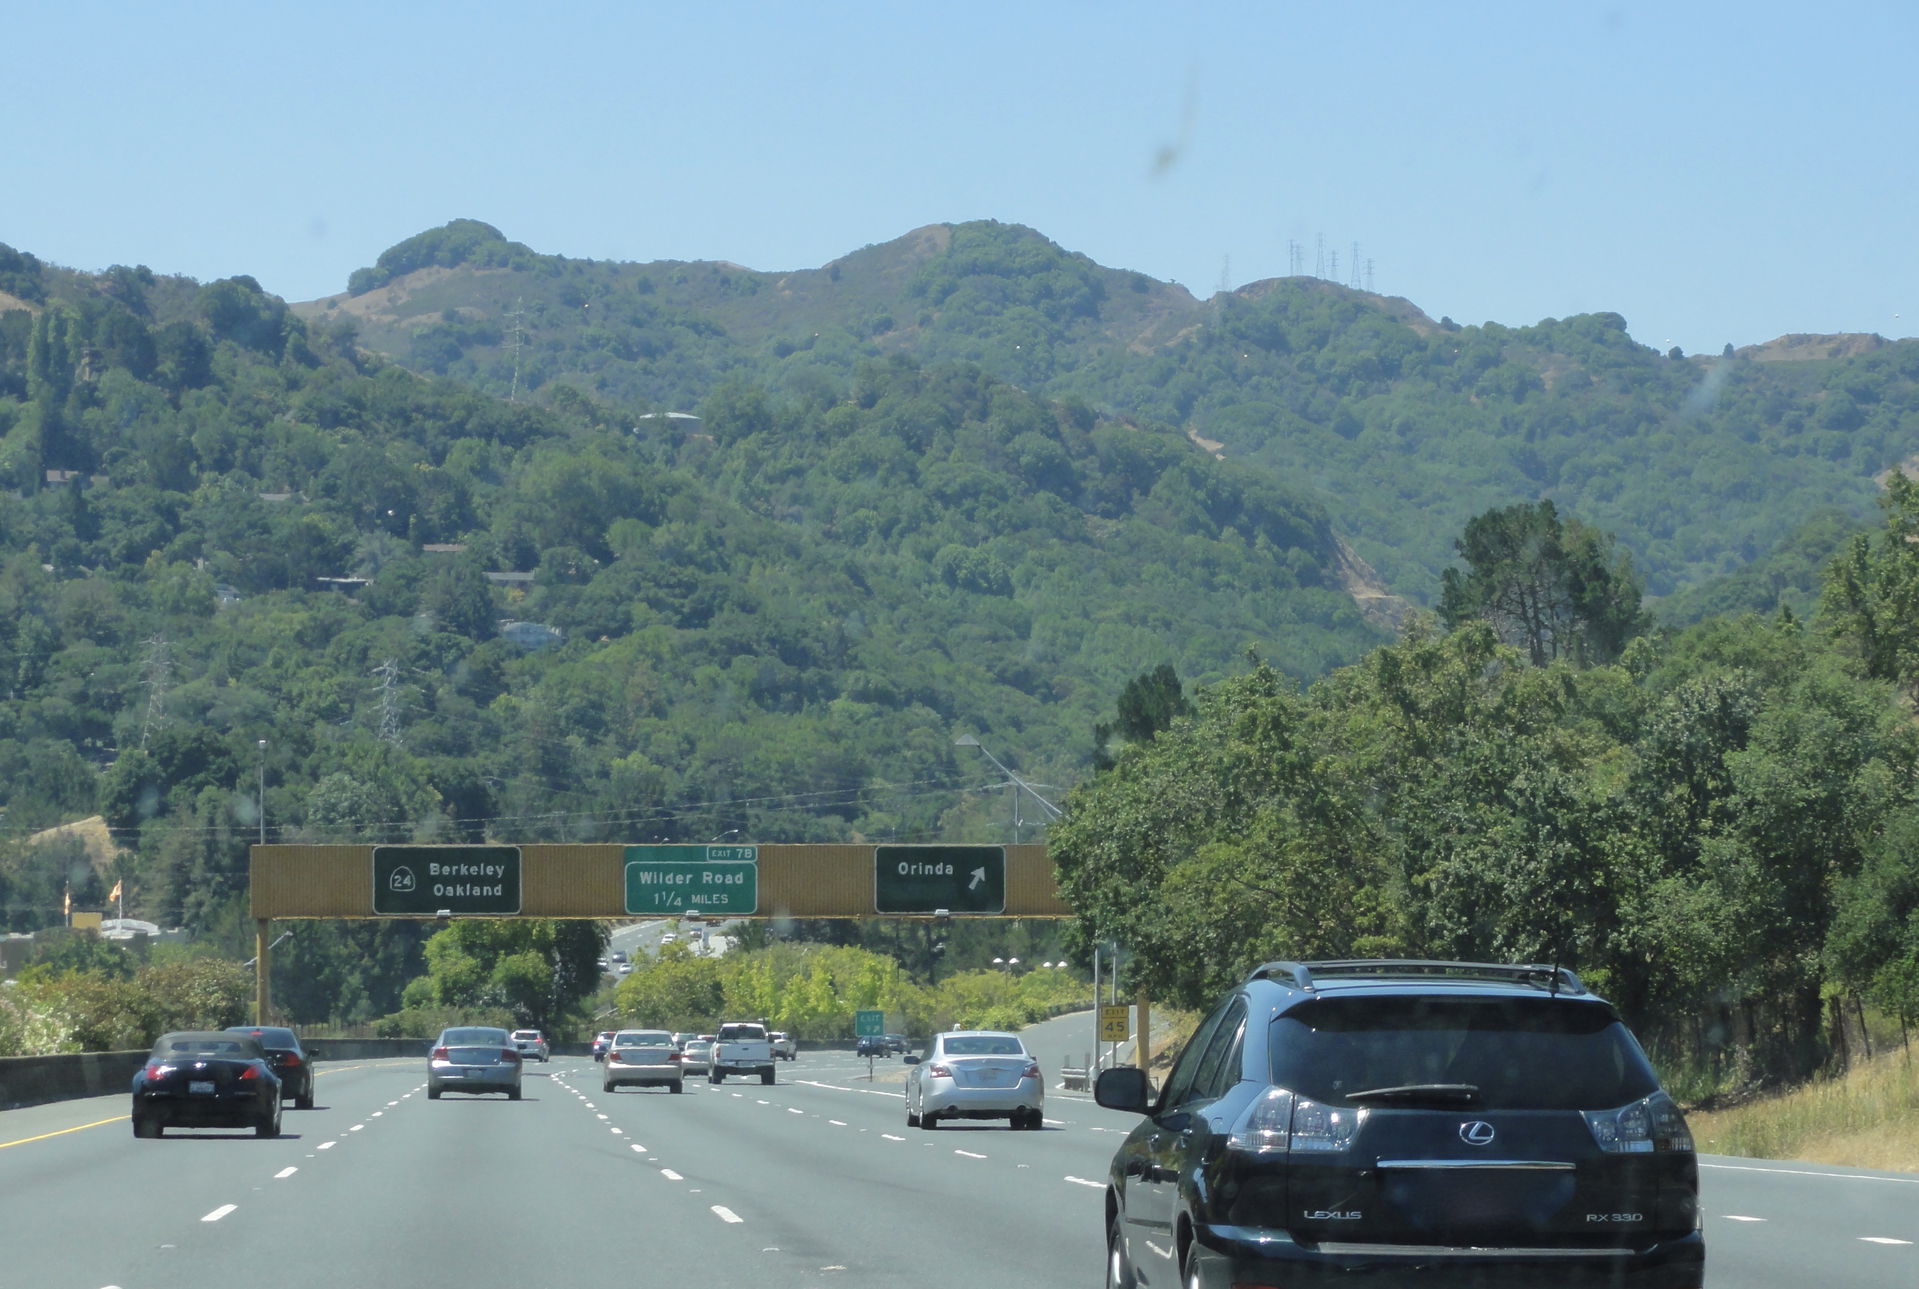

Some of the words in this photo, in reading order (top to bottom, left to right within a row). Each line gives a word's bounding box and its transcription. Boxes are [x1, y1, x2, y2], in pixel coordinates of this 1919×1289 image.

[736, 848, 753, 858] 7B
[429, 863, 505, 878] Berkeley
[898, 862, 954, 875] Orinda
[394, 875, 412, 887] 24
[640, 872, 693, 884] Wilder
[702, 872, 743, 884] Road
[433, 884, 502, 896] Oakland
[691, 894, 729, 904] MILES
[1105, 1021, 1125, 1032] 45
[1303, 1210, 1362, 1220] LEXUS
[1586, 1214, 1609, 1222] RX
[1611, 1213, 1643, 1222] 330
